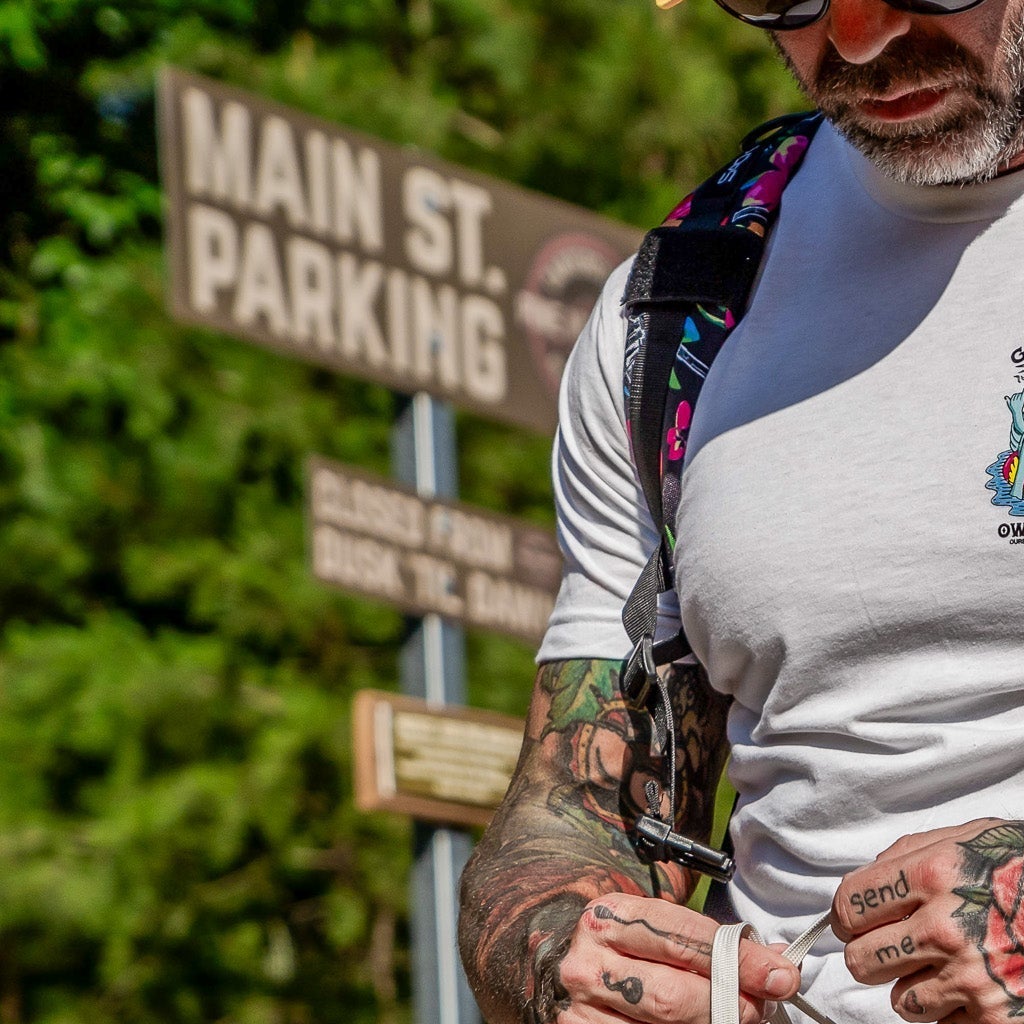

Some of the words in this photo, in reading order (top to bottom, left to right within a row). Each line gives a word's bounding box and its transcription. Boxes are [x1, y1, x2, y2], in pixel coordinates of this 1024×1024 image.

[182, 86, 384, 251] MAIN
[402, 165, 507, 295] ST.
[187, 203, 507, 402] PARKING
[850, 869, 911, 915] send
[875, 935, 916, 964] me
